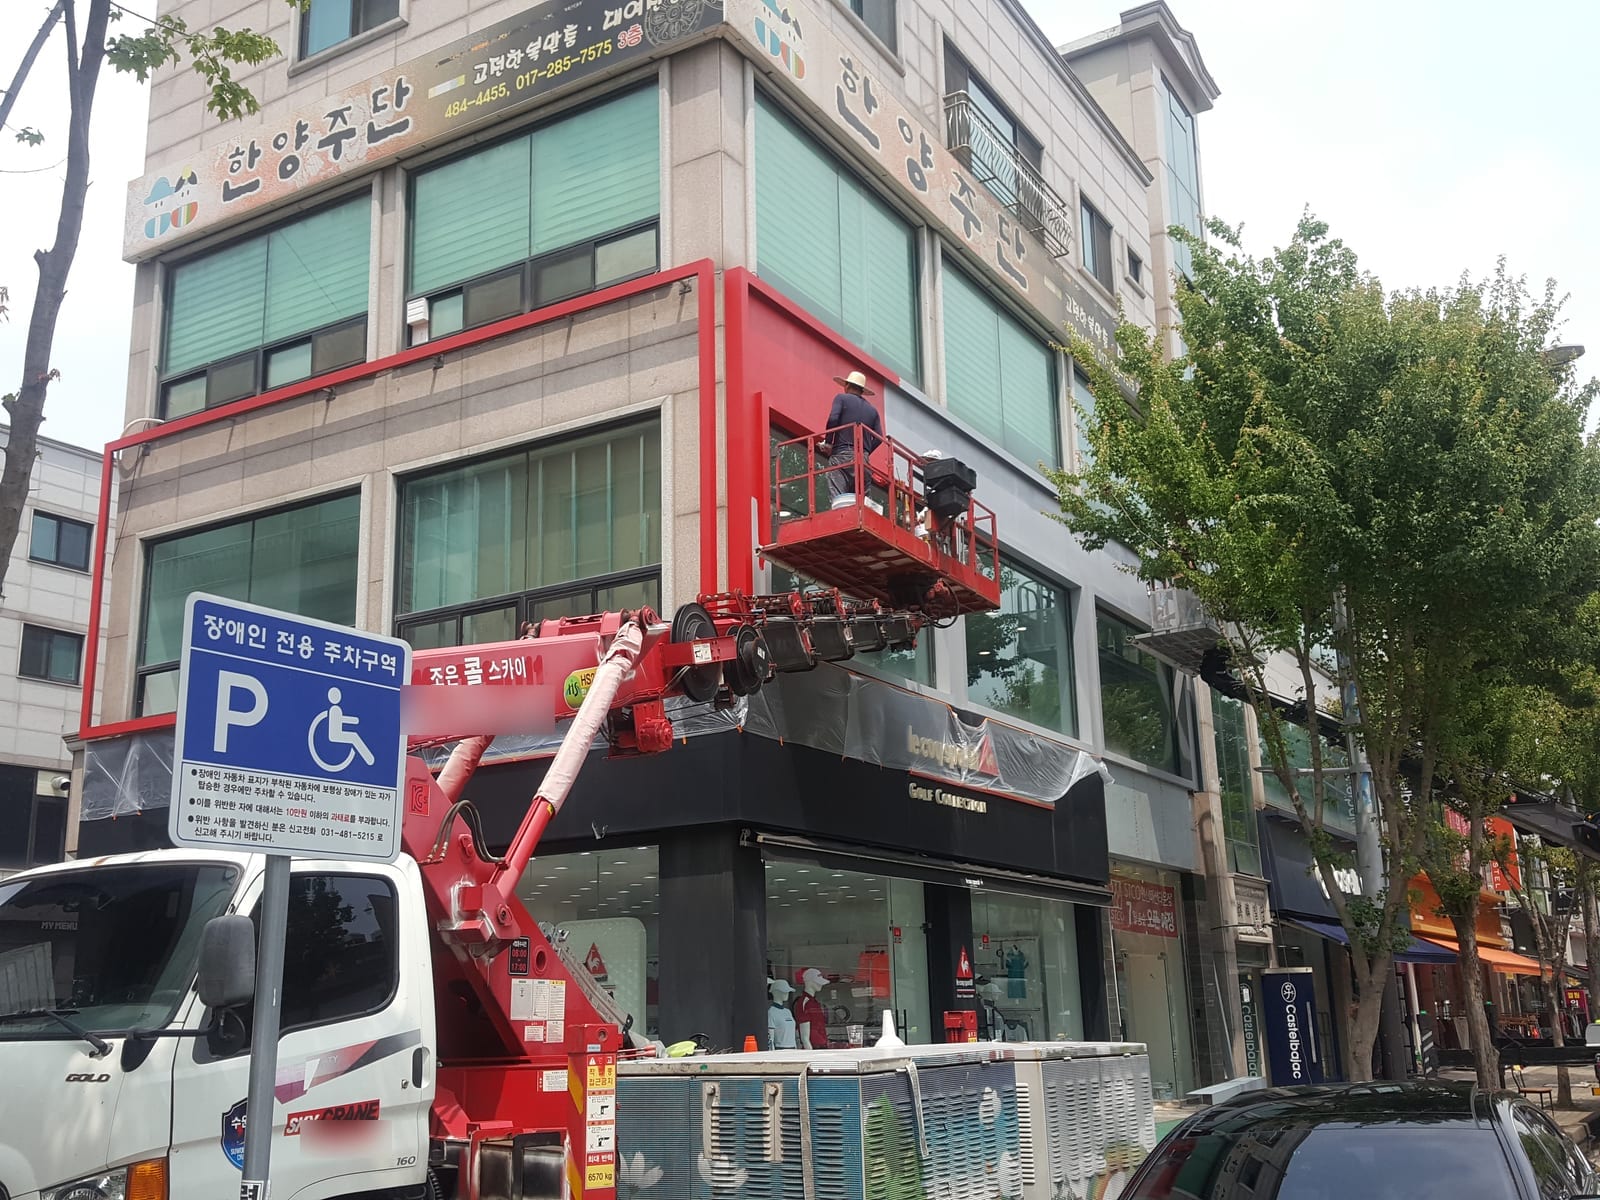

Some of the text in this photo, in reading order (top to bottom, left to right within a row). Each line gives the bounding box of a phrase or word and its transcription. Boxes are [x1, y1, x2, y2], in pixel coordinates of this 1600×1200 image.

[617, 24, 642, 50] 3층
[444, 38, 612, 119] 484-4455, 017-285-7575
[220, 76, 414, 203] 한양주단
[834, 55, 1029, 292] 한양주단
[203, 614, 396, 677] 장애인 전용 주차구역
[429, 656, 527, 686] 조은 콜 스카이
[213, 669, 269, 754] P
[198, 768, 391, 801] 장애인 자동차 표지가 부착된 자동차에 보행상 장애가 있는 자가
[198, 780, 316, 803] 탑승한 경우에만 주차할 수 있습니다.
[195, 814, 211, 825] 위반
[214, 816, 237, 828] 사항을
[240, 820, 269, 831] 발견하신
[272, 822, 286, 832] 분은
[289, 824, 316, 835] 신고전화
[321, 828, 375, 840] 031-481-5215
[196, 798, 211, 808] 이를
[214, 800, 236, 810] 위반한
[255, 804, 284, 816] 대해서는
[286, 808, 307, 818] 10만원
[309, 810, 329, 820] 이하의
[358, 816, 390, 827] 부과합니다.
[195, 826, 274, 842] 신고해 주시기 바랍니다.
[65, 1073, 111, 1083] GOLD
[396, 1156, 416, 1166] 160
[588, 1172, 604, 1181] 6570
